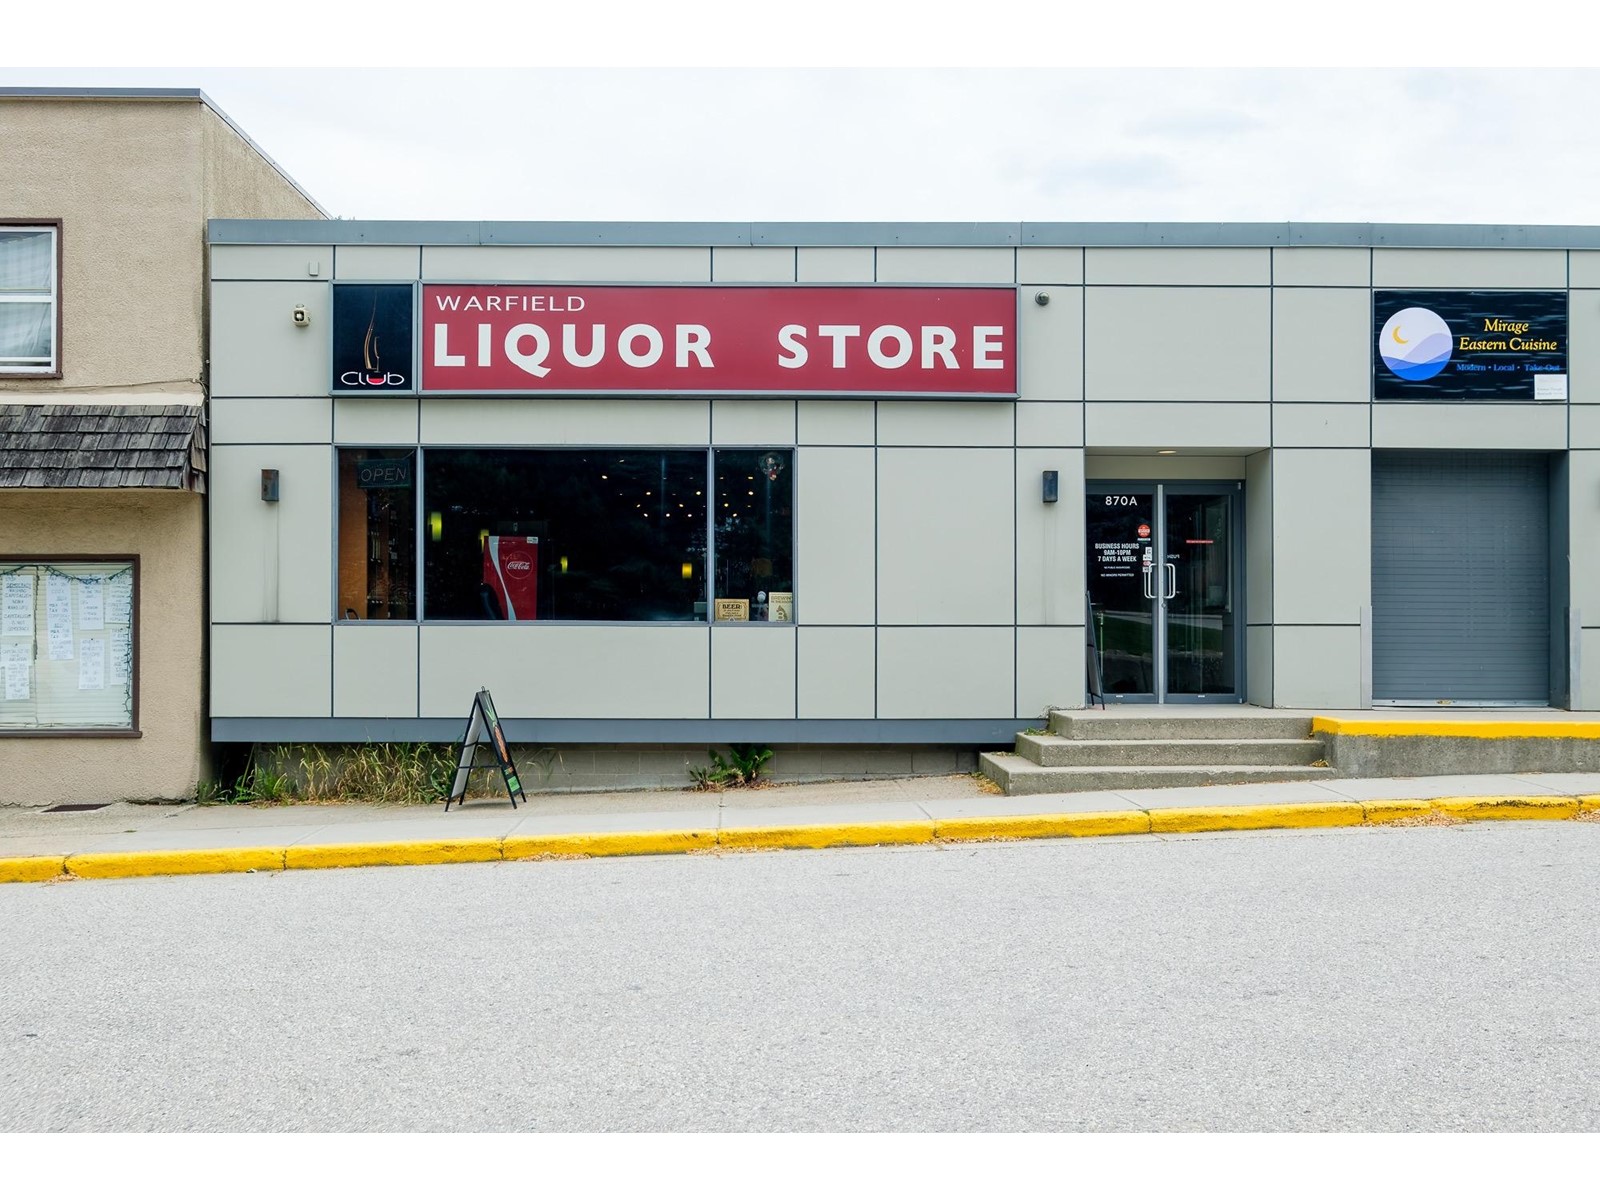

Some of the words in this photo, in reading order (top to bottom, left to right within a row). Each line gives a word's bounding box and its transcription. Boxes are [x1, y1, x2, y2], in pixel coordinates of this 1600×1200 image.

[436, 295, 586, 312] WARFIELD
[1484, 318, 1529, 334] Mirage
[434, 323, 715, 378] LIQUOR
[777, 324, 1005, 370] STORE
[1459, 337, 1507, 351] Eastern
[1509, 337, 1557, 351] Cuisine
[1456, 363, 1487, 371] Modern
[1493, 363, 1515, 371] Local
[360, 467, 407, 482] OPEN
[1105, 496, 1138, 506] 870A
